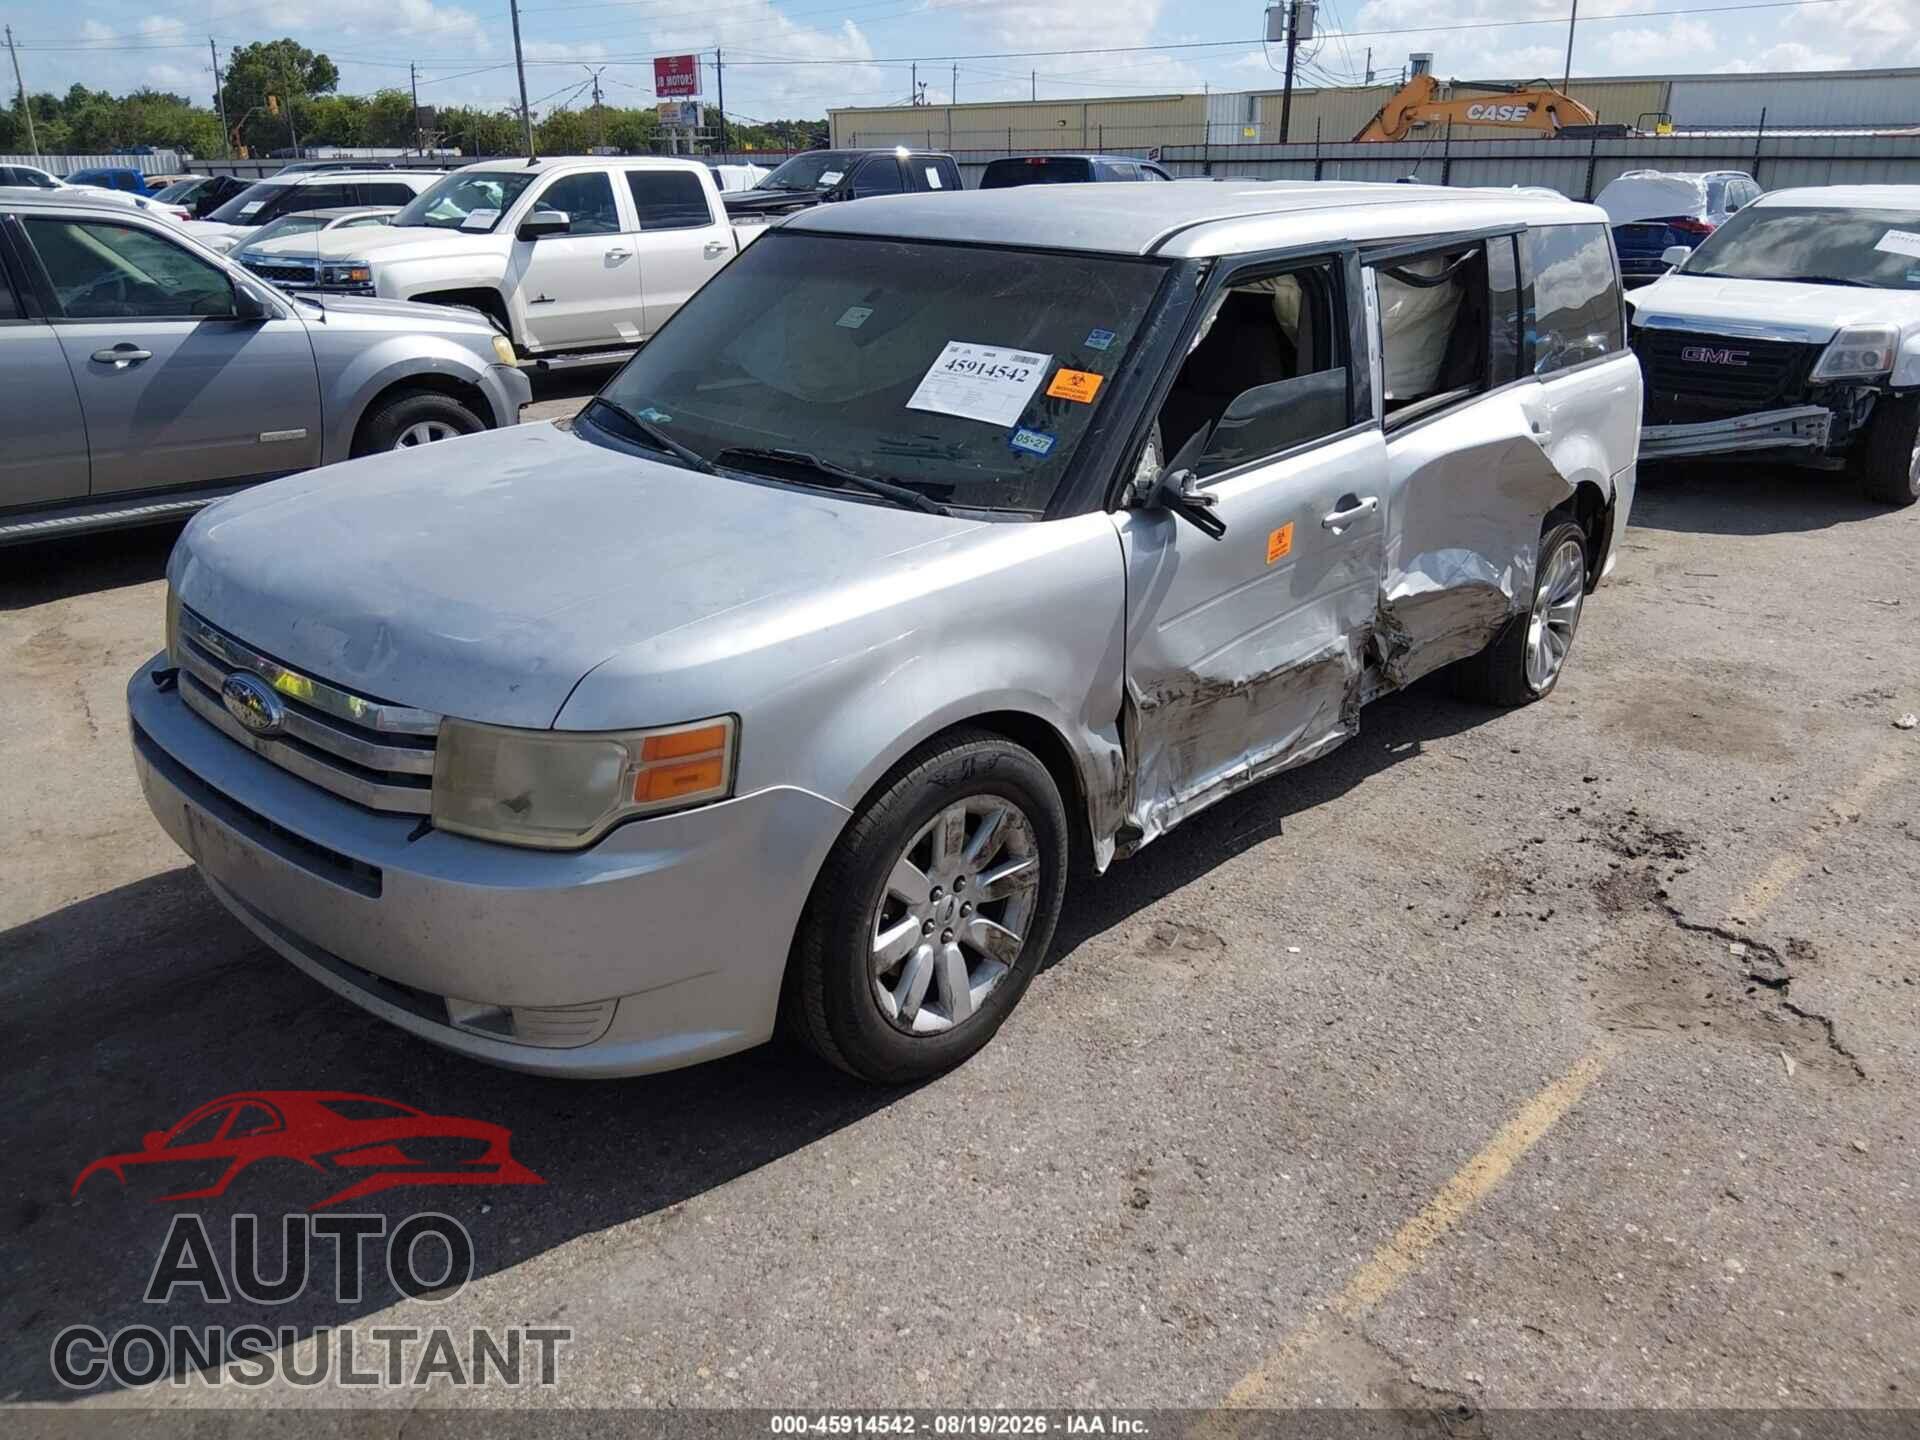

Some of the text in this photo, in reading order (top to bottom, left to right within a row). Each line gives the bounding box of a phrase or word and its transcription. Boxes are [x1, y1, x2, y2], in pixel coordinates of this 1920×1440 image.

[1467, 104, 1529, 121] CASE
[1681, 346, 1750, 366] GMC
[944, 358, 1030, 383] 45914542
